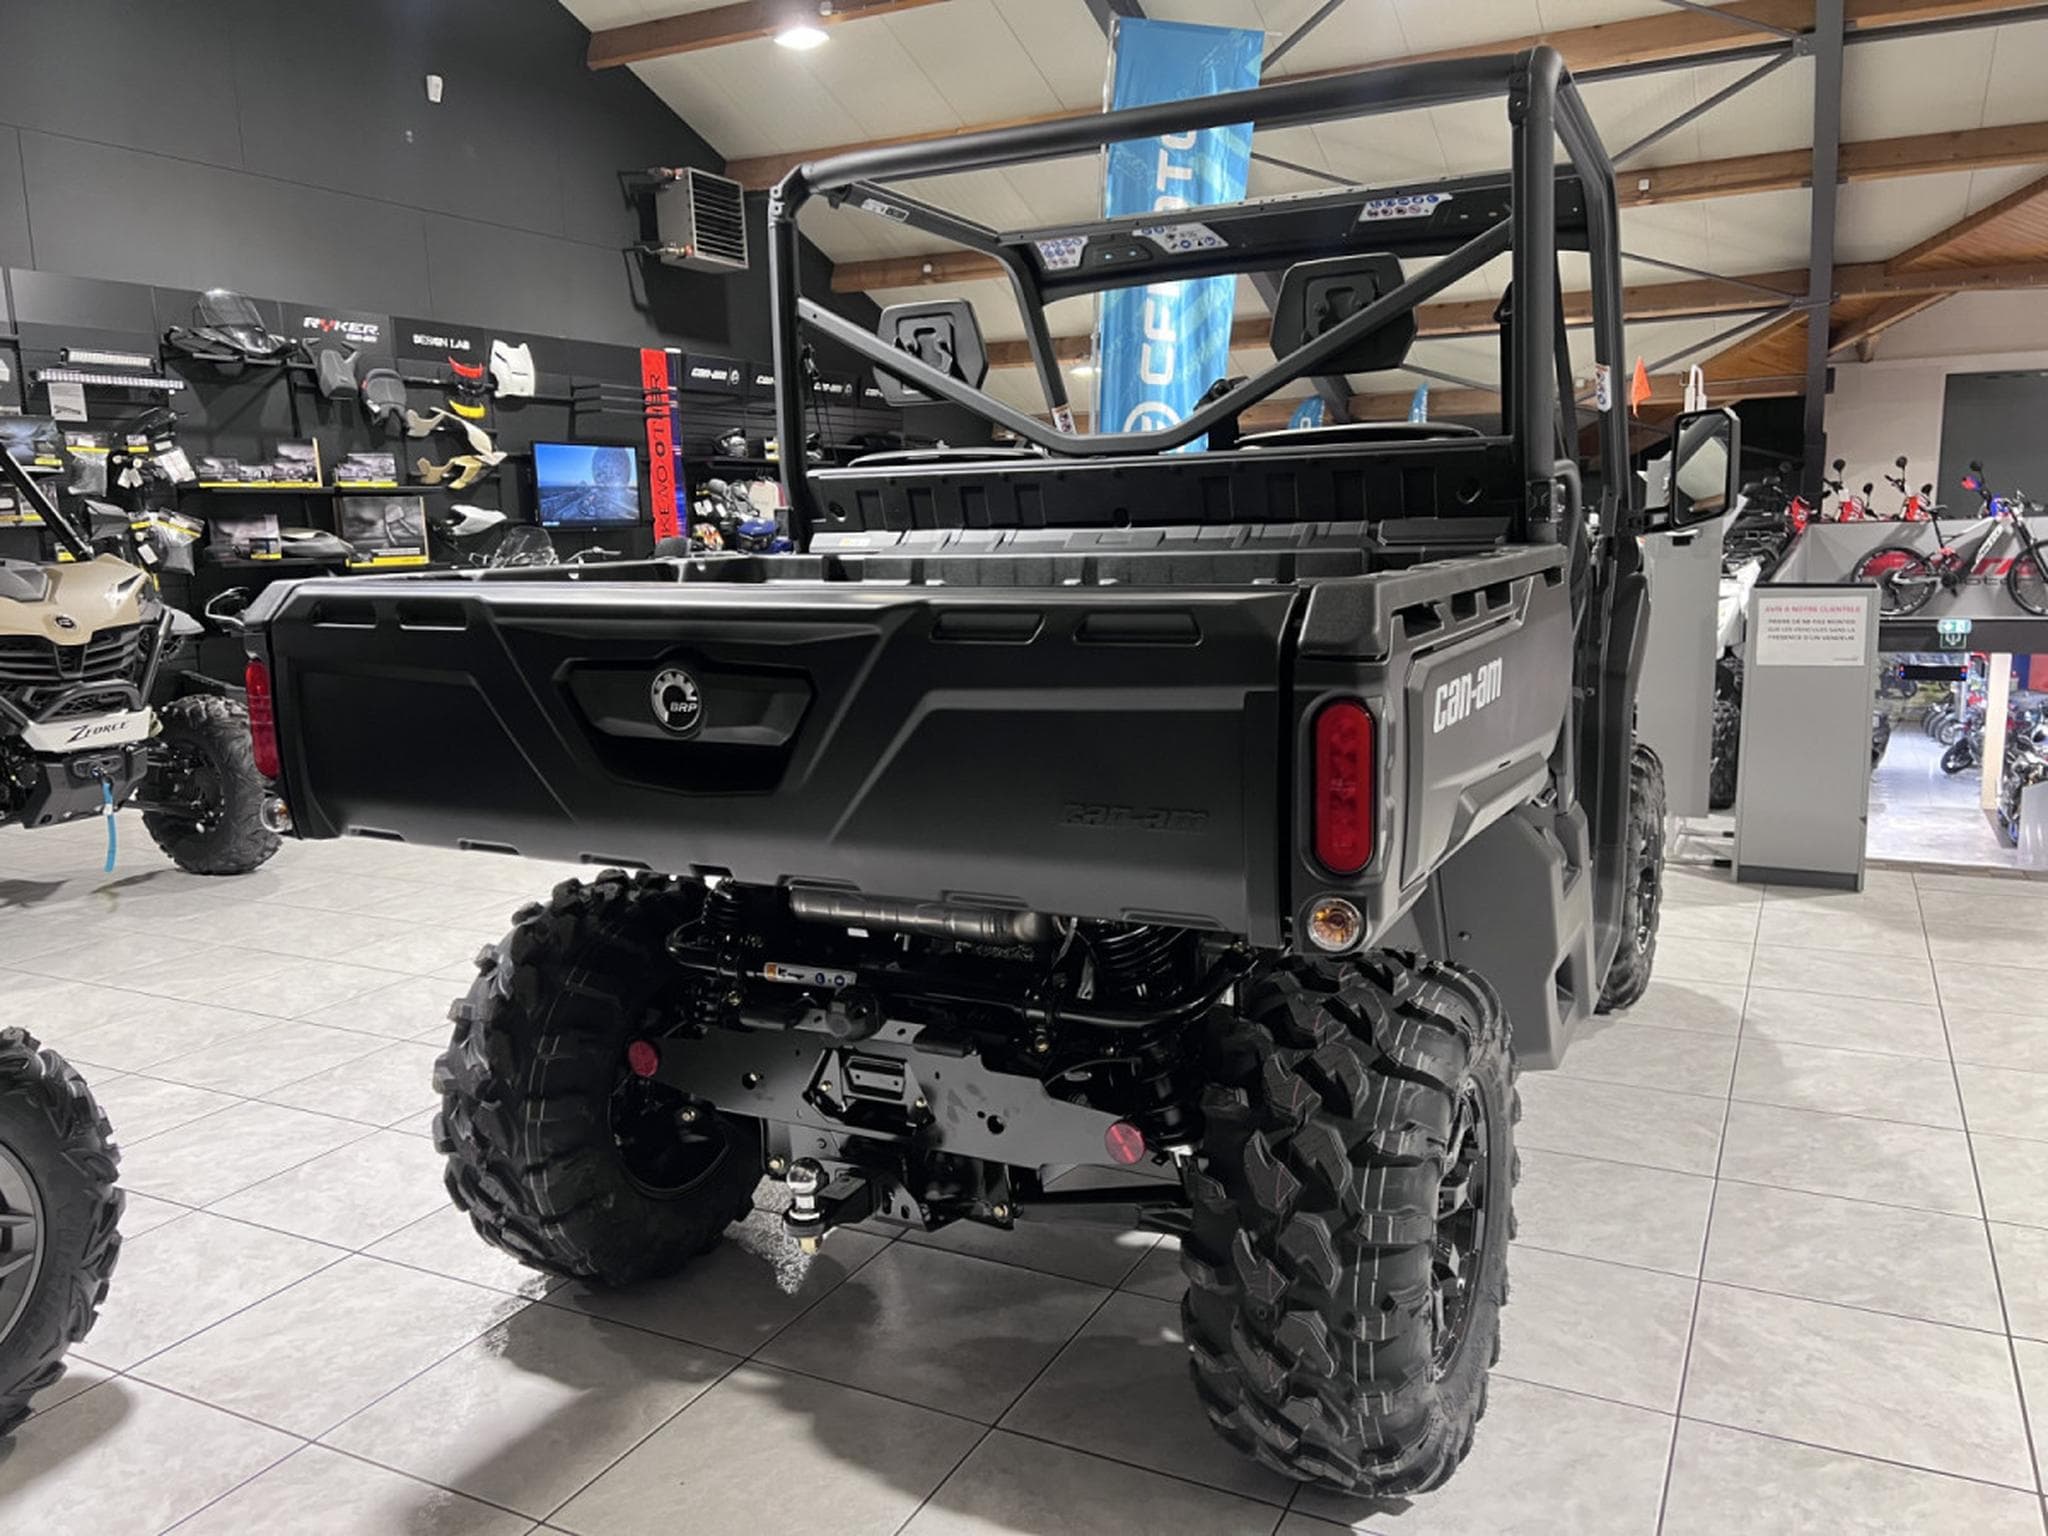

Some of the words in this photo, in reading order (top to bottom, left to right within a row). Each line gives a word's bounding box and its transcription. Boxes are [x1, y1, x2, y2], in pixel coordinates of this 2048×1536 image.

[451, 338, 471, 350] LAB
[656, 465, 668, 497] NO
[1432, 656, 1503, 734] can-am
[669, 702, 698, 713] BRP
